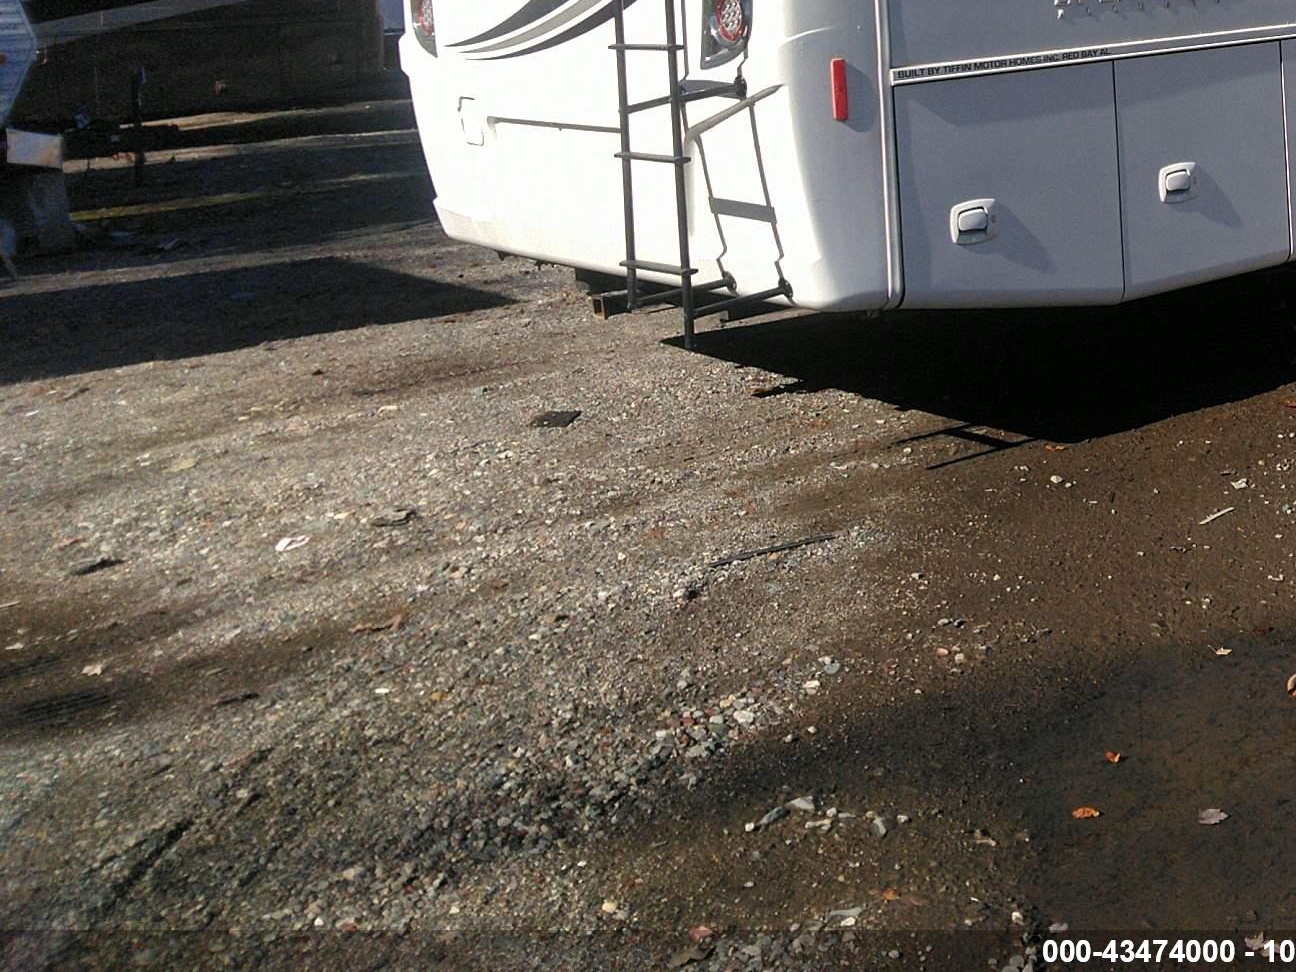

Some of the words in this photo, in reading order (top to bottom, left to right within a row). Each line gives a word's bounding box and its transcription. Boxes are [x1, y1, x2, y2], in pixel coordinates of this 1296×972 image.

[898, 69, 925, 79] BUILT
[927, 66, 942, 76] BY
[944, 64, 971, 73] TIFFIN
[974, 60, 1007, 69] MOTOR
[1009, 56, 1041, 67] HOMES
[1062, 51, 1080, 60] RED
[1081, 49, 1099, 59] BAY
